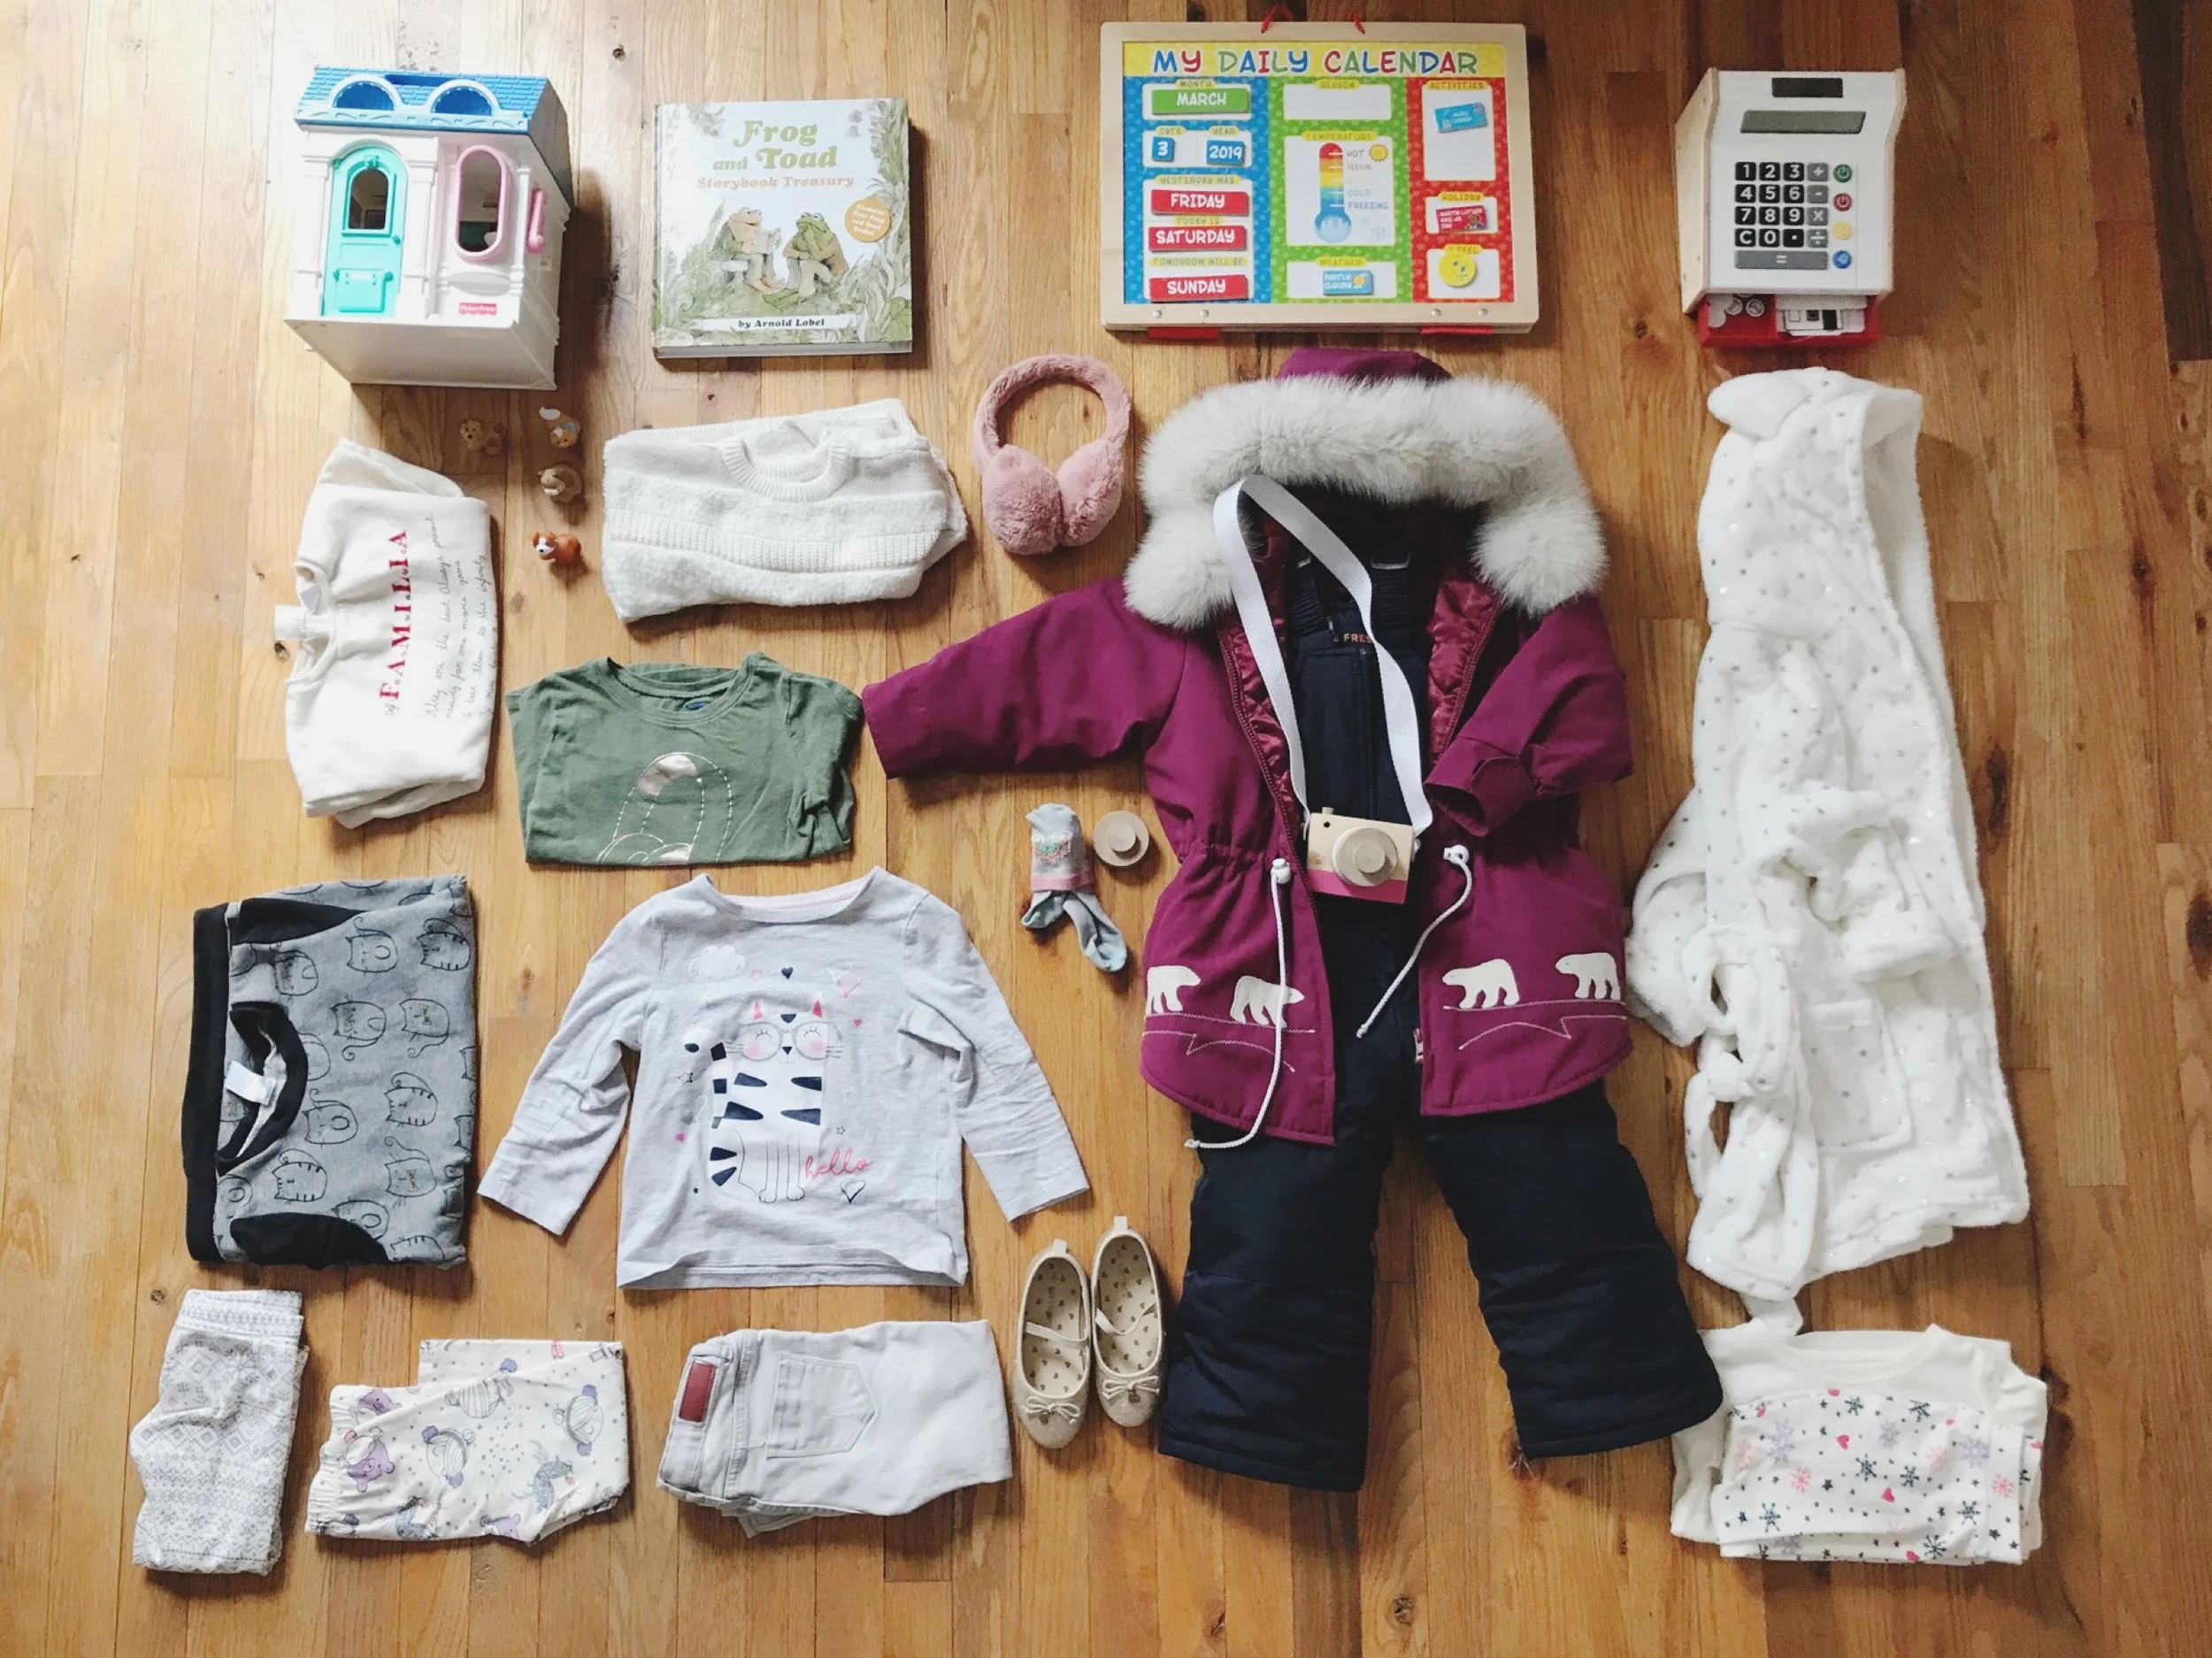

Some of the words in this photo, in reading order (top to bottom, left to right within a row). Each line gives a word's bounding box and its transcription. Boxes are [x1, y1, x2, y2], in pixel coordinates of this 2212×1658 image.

[1153, 50, 1202, 73] MY
[1217, 50, 1309, 73] DAILY
[1324, 50, 1478, 74] CALENDAR
[1176, 92, 1227, 106] MARCH
[733, 120, 818, 148] Frog
[1157, 141, 1169, 157] 3
[1208, 145, 1243, 160] 2019
[1347, 150, 1365, 158] HOT
[713, 157, 749, 171] and
[756, 145, 838, 170] Toad
[1743, 164, 1750, 178] 1
[1764, 164, 1776, 179] 2
[1789, 164, 1800, 179] 3
[697, 177, 779, 191] Storybook
[783, 175, 855, 188] Treasury
[1170, 193, 1225, 208] FRIDAY
[1441, 193, 1481, 202] HOLIDAY
[1740, 186, 1753, 201] 4
[1765, 186, 1777, 200] 5
[1789, 186, 1801, 201] 6
[1348, 201, 1389, 211] FREEZING
[1177, 217, 1207, 226] TODAY
[1740, 207, 1752, 222] 7
[1764, 208, 1776, 222] 8
[1789, 208, 1801, 222] 9
[1155, 229, 1235, 244] SATURDAY
[1739, 230, 1753, 245] C
[1153, 257, 1206, 265] TOMORROW
[1209, 257, 1230, 265] WILL
[1233, 257, 1243, 265] BE
[1167, 278, 1227, 295] SUNDAY
[738, 319, 751, 329] by
[754, 319, 793, 327] Arnold
[795, 318, 826, 327] Lobel
[805, 1147, 875, 1179] hello
